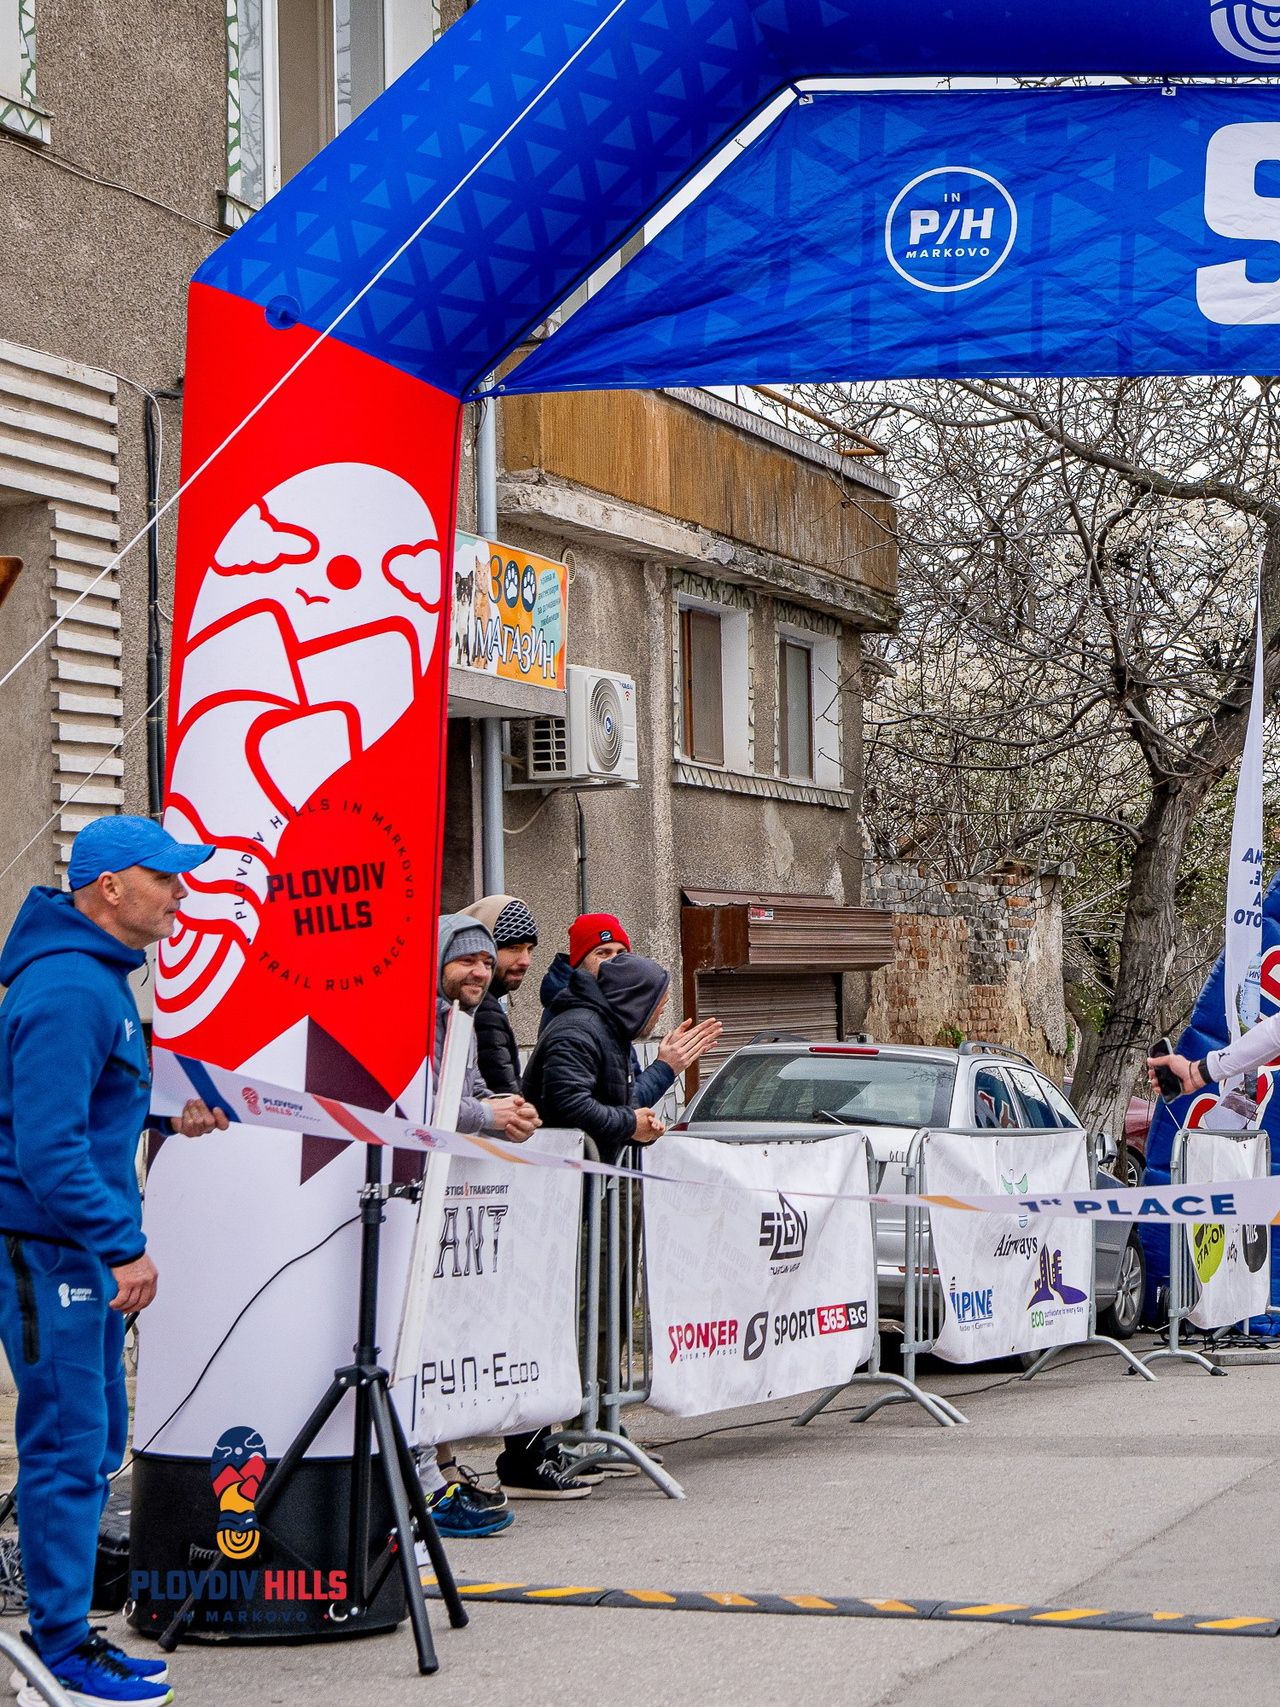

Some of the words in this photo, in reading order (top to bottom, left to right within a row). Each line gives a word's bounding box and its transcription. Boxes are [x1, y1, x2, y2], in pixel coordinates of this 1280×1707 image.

[943, 192, 961, 202] IN
[909, 207, 995, 245] P/H
[906, 247, 990, 259] MARKOVO
[474, 616, 556, 679] МАГАЗИН
[234, 831, 265, 920] PLOVDIV
[269, 798, 330, 830] HILLS
[343, 799, 363, 815] IN
[266, 861, 385, 903] PLOVDIV
[293, 900, 373, 936] HILLS
[258, 951, 312, 989] TRAIL
[325, 975, 364, 991] RUN
[372, 935, 406, 977] RACE
[470, 1184, 509, 1196] TRANSPORT
[1073, 1193, 1237, 1216] PLACE
[433, 1204, 509, 1279] ANT
[1031, 1310, 1045, 1328] ECO
[668, 1319, 739, 1365] SPONSER
